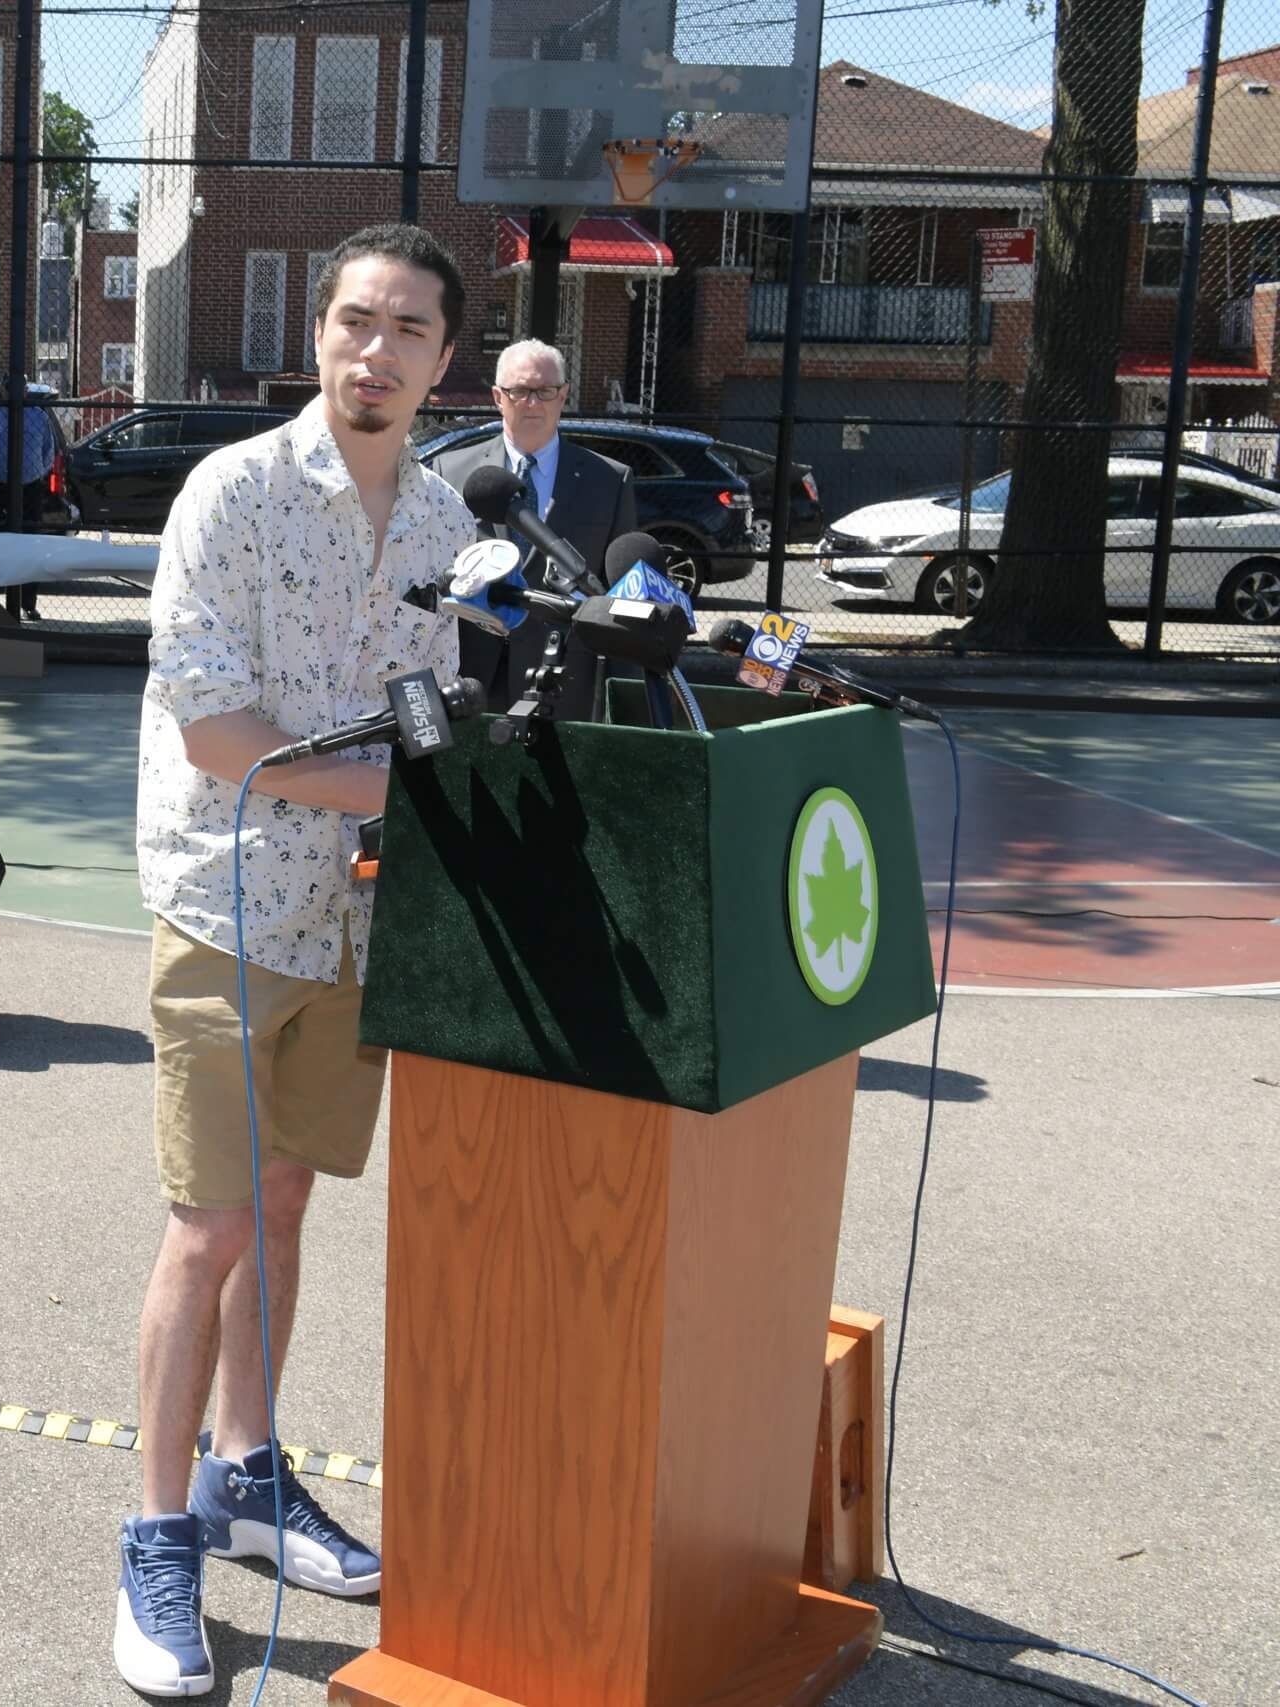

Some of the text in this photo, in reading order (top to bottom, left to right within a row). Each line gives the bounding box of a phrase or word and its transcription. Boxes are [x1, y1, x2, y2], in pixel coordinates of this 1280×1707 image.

[761, 614, 796, 642] 2
[778, 625, 808, 670] NEWS
[767, 670, 787, 696] NEWS
[402, 680, 429, 727] NEWS
